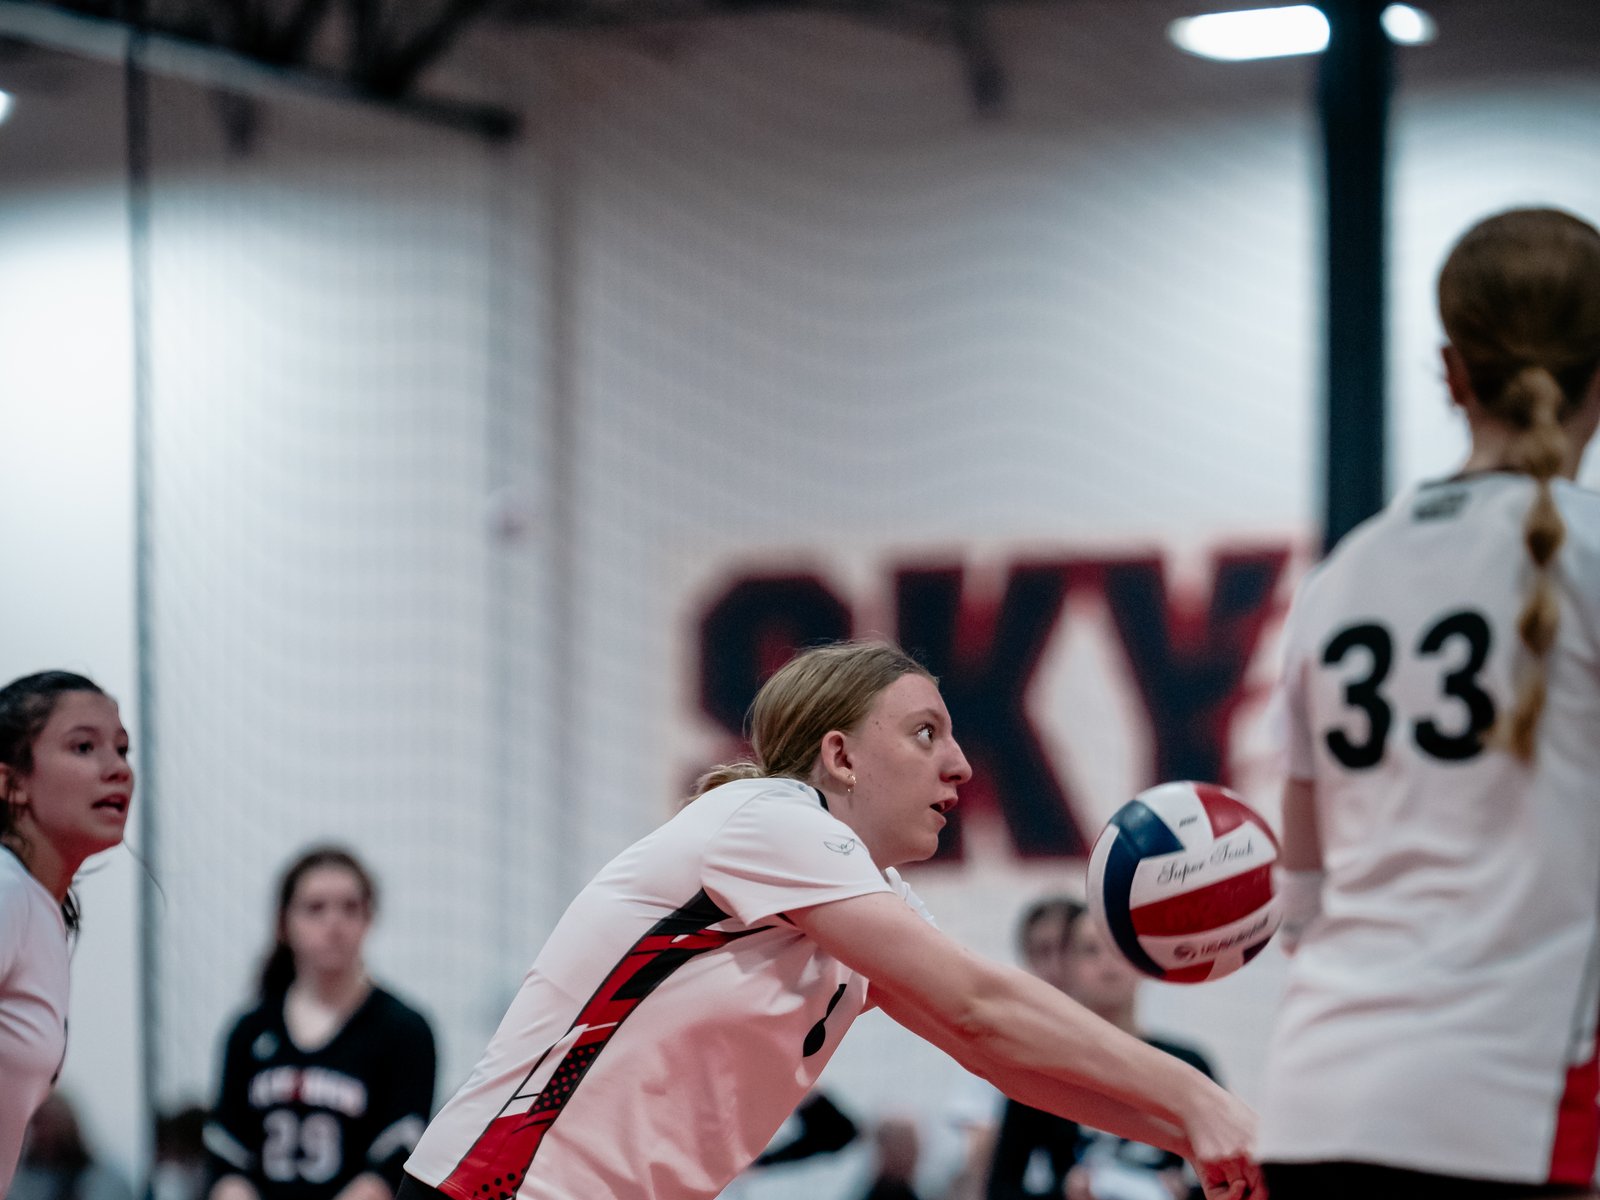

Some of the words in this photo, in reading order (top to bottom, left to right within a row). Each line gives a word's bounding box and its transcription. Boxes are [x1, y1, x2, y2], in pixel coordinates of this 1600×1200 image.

[1321, 611, 1495, 769] 33
[1156, 860, 1205, 884] Super
[1210, 837, 1254, 864] Touch
